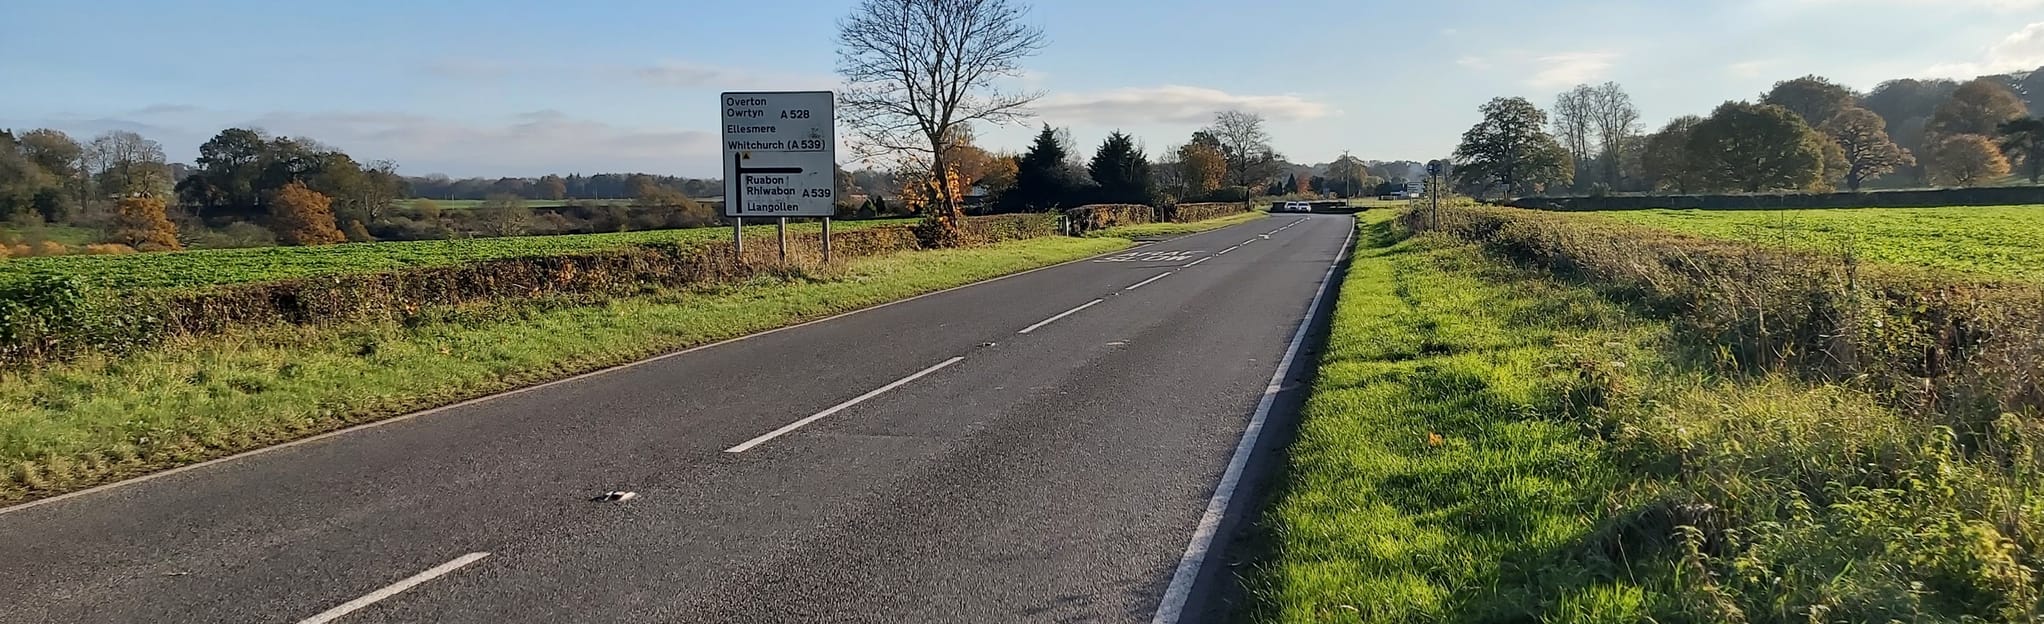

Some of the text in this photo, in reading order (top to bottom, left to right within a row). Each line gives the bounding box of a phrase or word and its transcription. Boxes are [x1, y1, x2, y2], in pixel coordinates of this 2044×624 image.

[727, 97, 767, 106] Overton
[727, 108, 764, 118] Owrtyn
[727, 125, 776, 133] Ellesmere
[728, 140, 784, 150] Whitchurch
[746, 175, 784, 184] Ruabon
[747, 186, 795, 195] Rhiwabon
[747, 202, 799, 212] Llangollen
